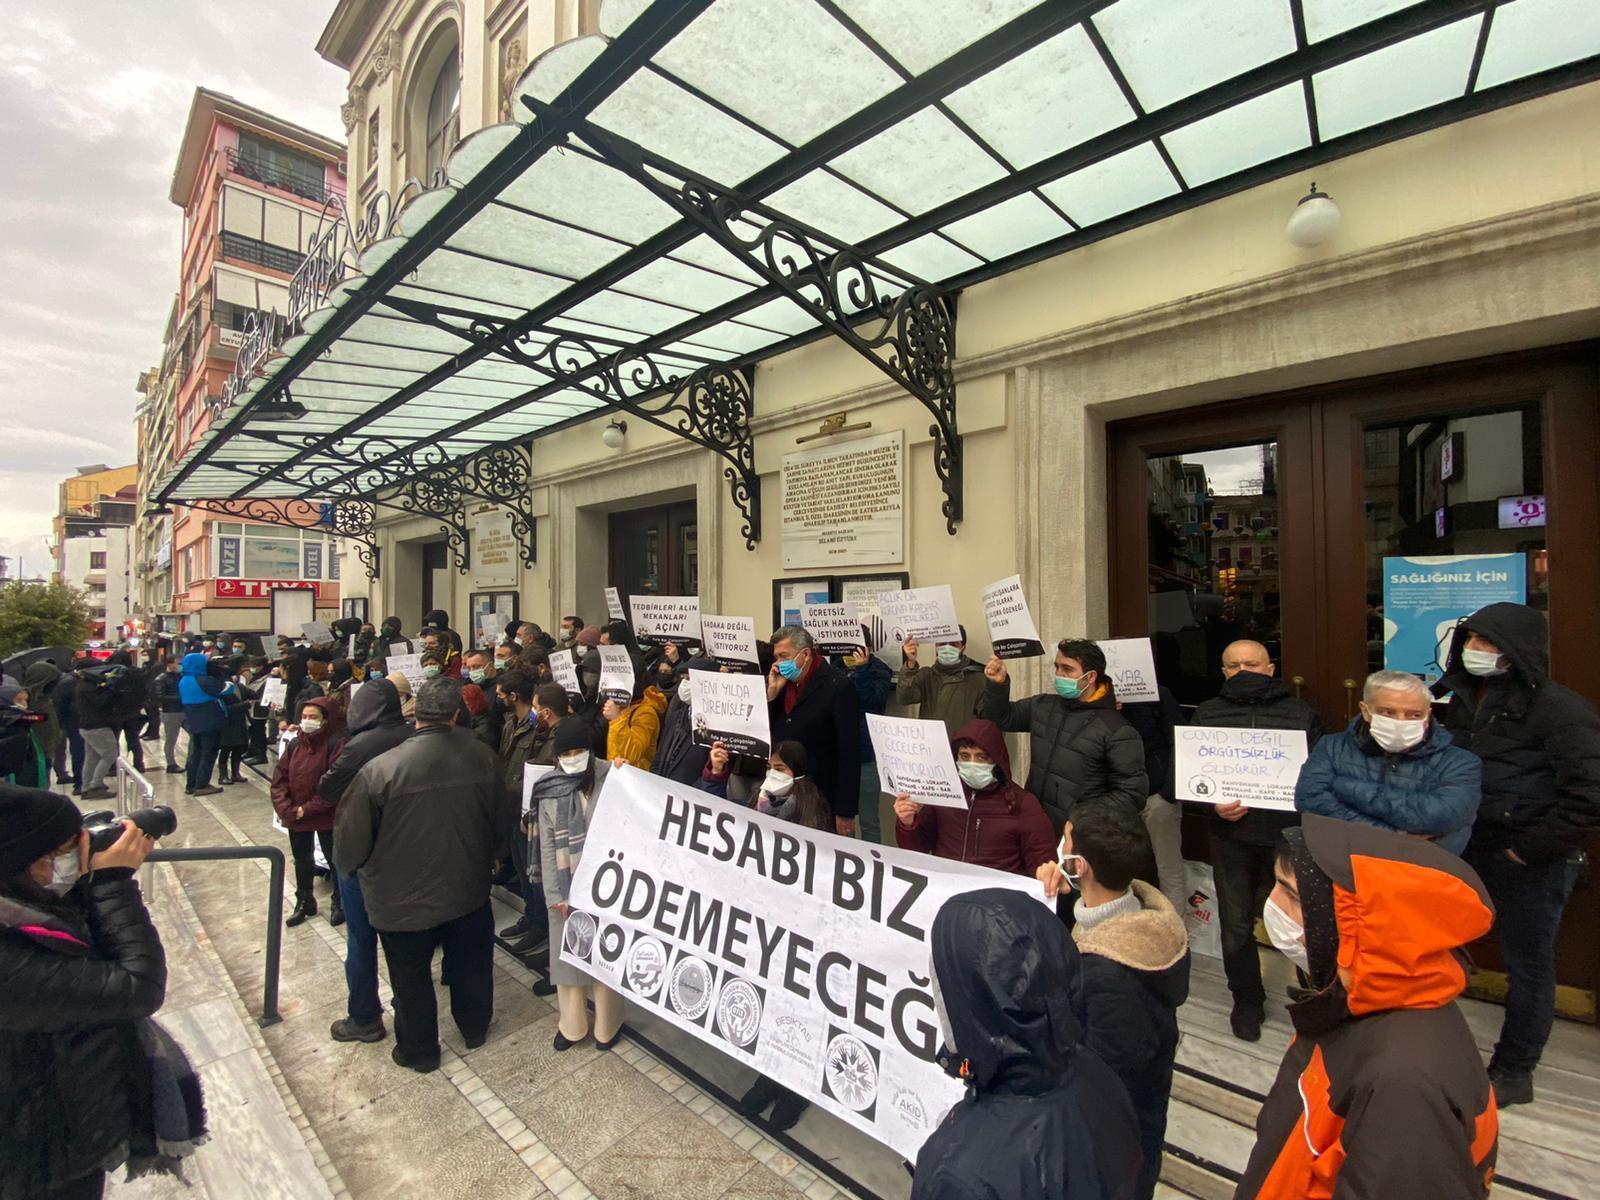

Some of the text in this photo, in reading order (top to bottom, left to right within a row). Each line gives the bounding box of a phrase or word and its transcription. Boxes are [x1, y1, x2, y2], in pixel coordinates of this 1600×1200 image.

[308, 549, 318, 577] OTEL
[1390, 570, 1507, 584] SAĞLIĞINIZ İÇİN
[632, 603, 676, 611] TEDBİRLERİ
[809, 608, 845, 616] ÜCRETSİZ
[655, 623, 684, 632] AÇIN!
[704, 620, 750, 632] SADAKA DEĞİL,
[804, 618, 858, 627] SAĞLIK HAKKI
[713, 632, 737, 640] DESTEK
[818, 630, 860, 638] İSTİYORUZ
[714, 642, 748, 652] İSTİYORUZ
[1114, 669, 1143, 682] VAR
[1199, 745, 1290, 760] ÖRGÜTSÜZLÜK
[659, 795, 928, 942] HESABI BİZ
[592, 848, 937, 1064] ÖDEMEYECEĞ
